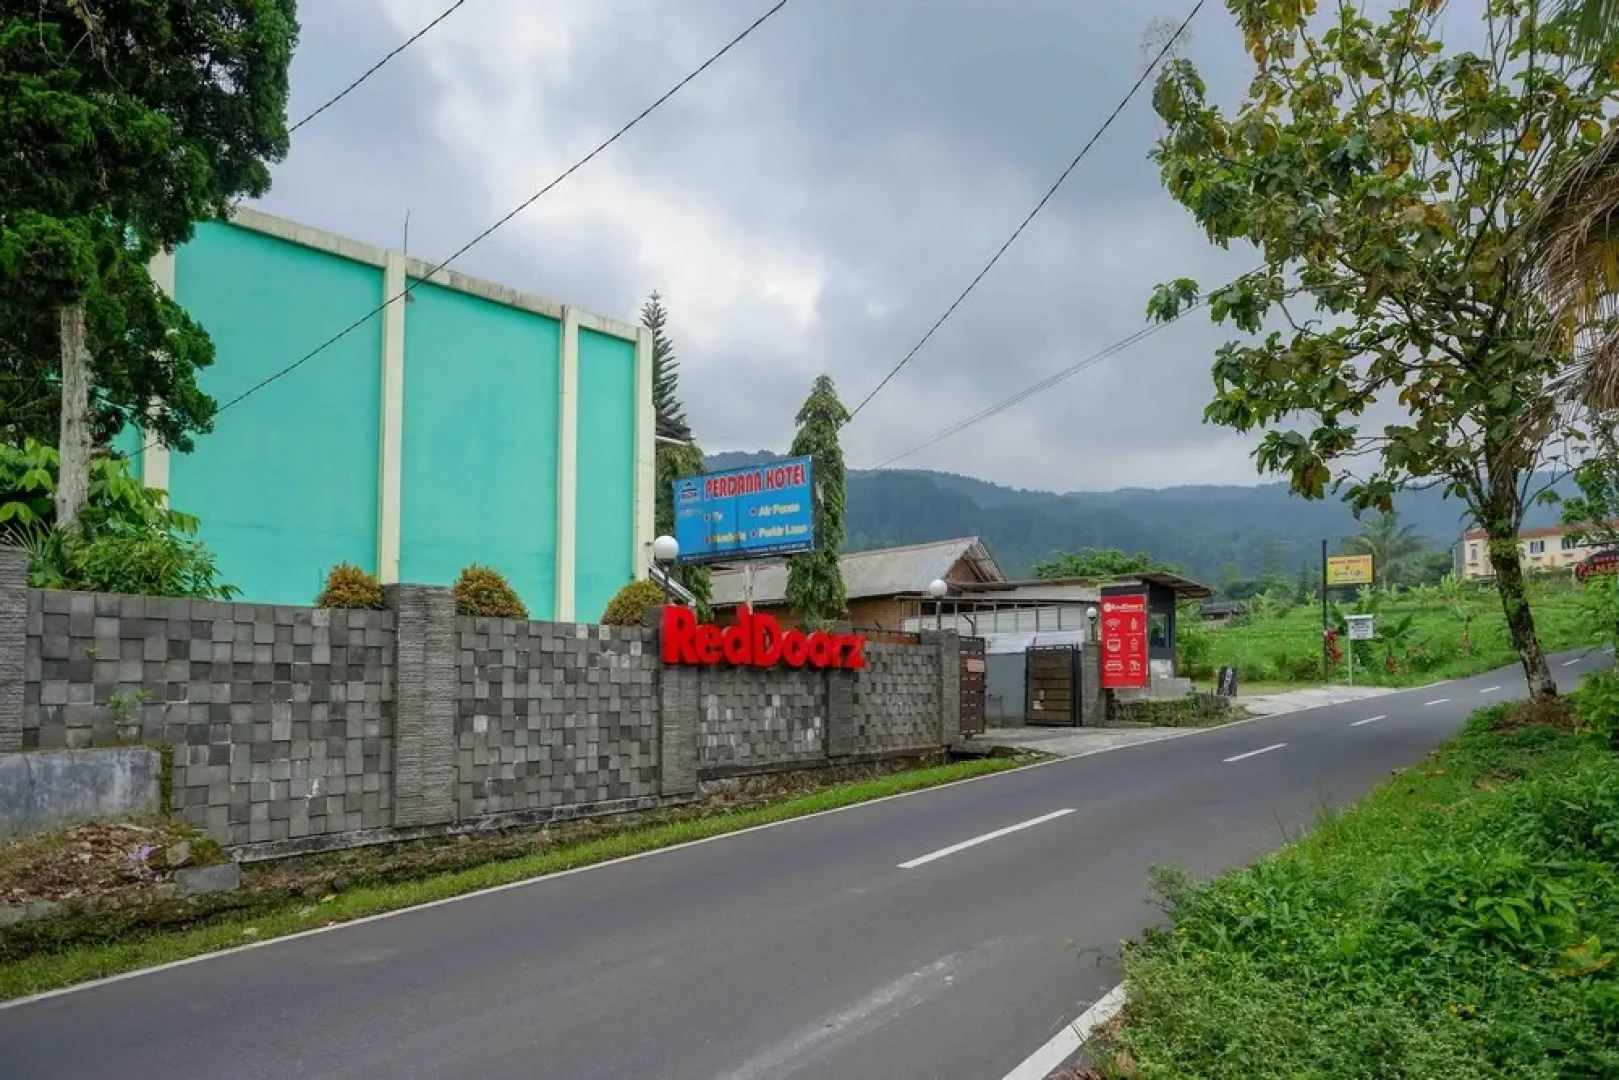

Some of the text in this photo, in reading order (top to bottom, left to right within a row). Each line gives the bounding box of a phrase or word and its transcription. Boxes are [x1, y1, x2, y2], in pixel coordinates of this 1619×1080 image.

[705, 462, 806, 500] PERDANA HOTEL
[660, 601, 866, 669] RedDoorz
